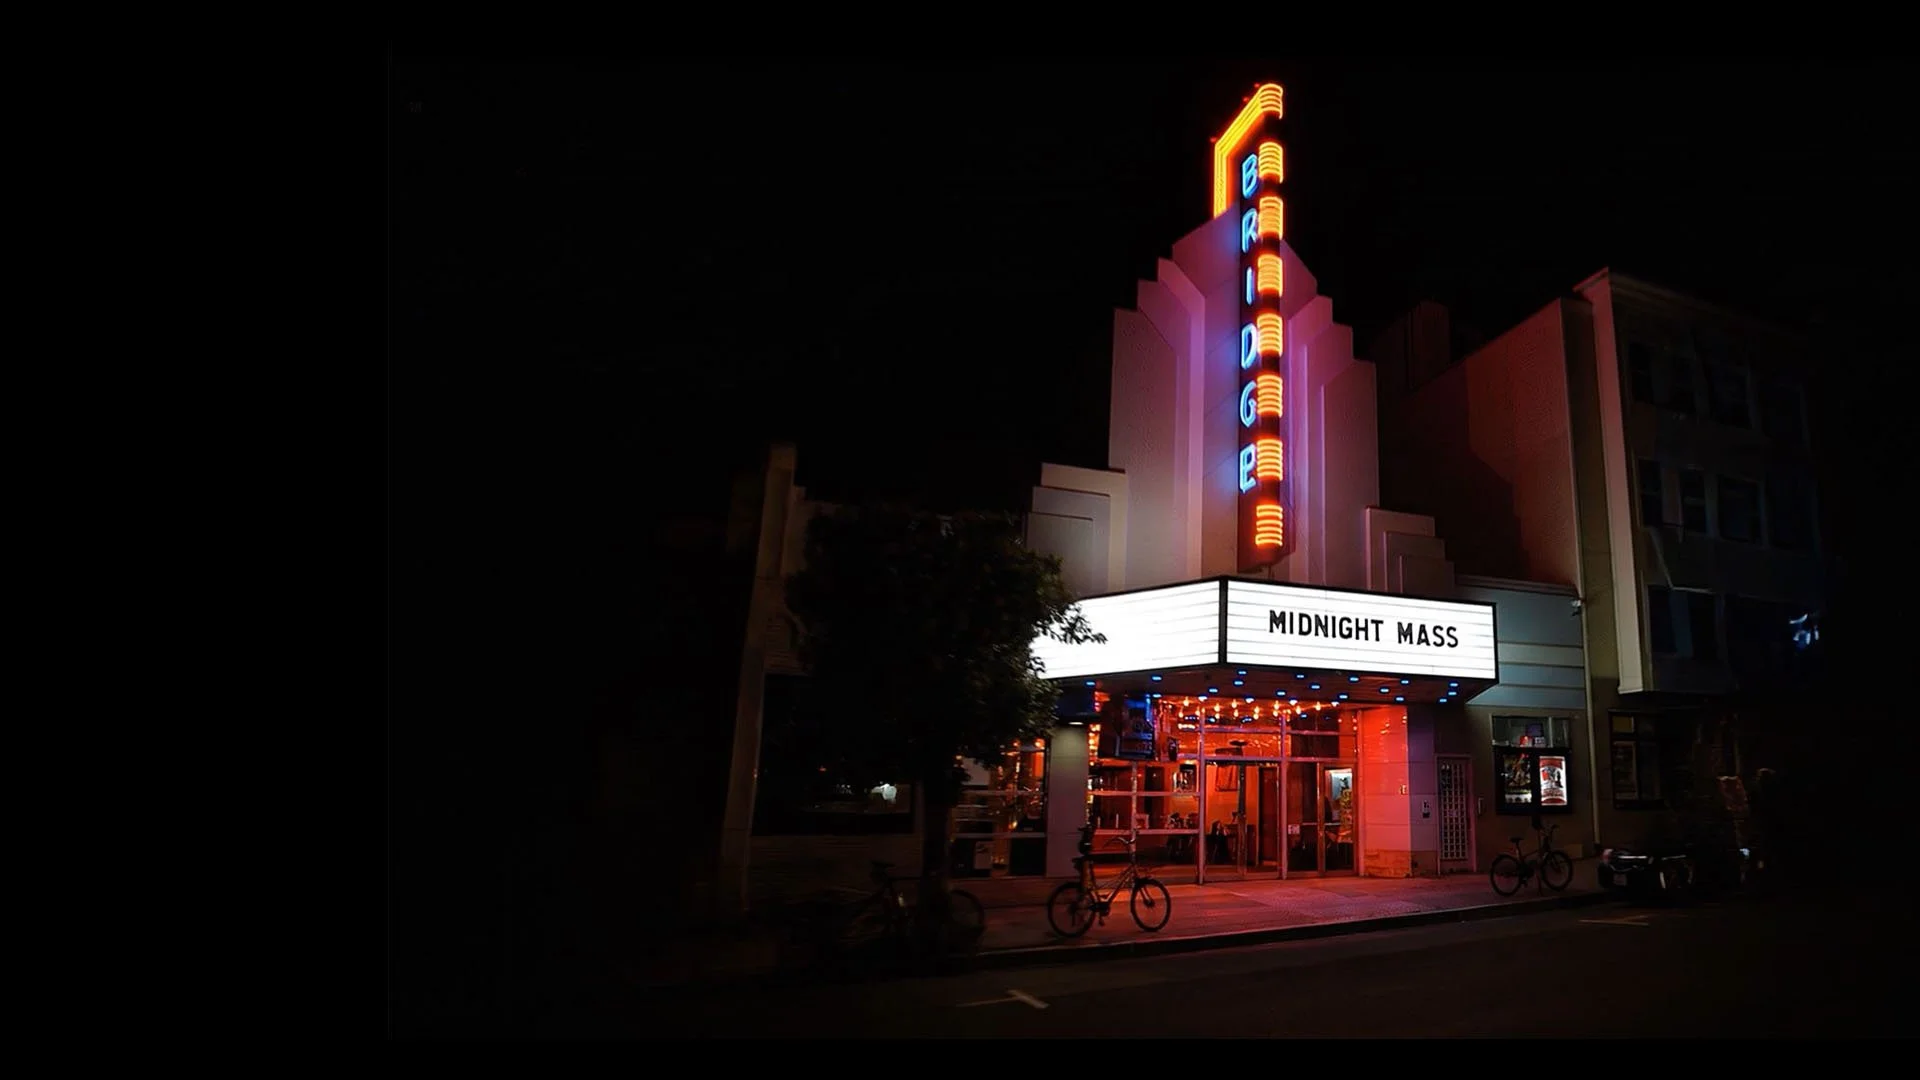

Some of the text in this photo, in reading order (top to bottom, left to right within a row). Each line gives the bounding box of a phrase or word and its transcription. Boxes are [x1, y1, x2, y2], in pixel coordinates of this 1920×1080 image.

[1240, 153, 1258, 493] BRIDGE
[1269, 609, 1459, 648] MIDNIGHT MASS
